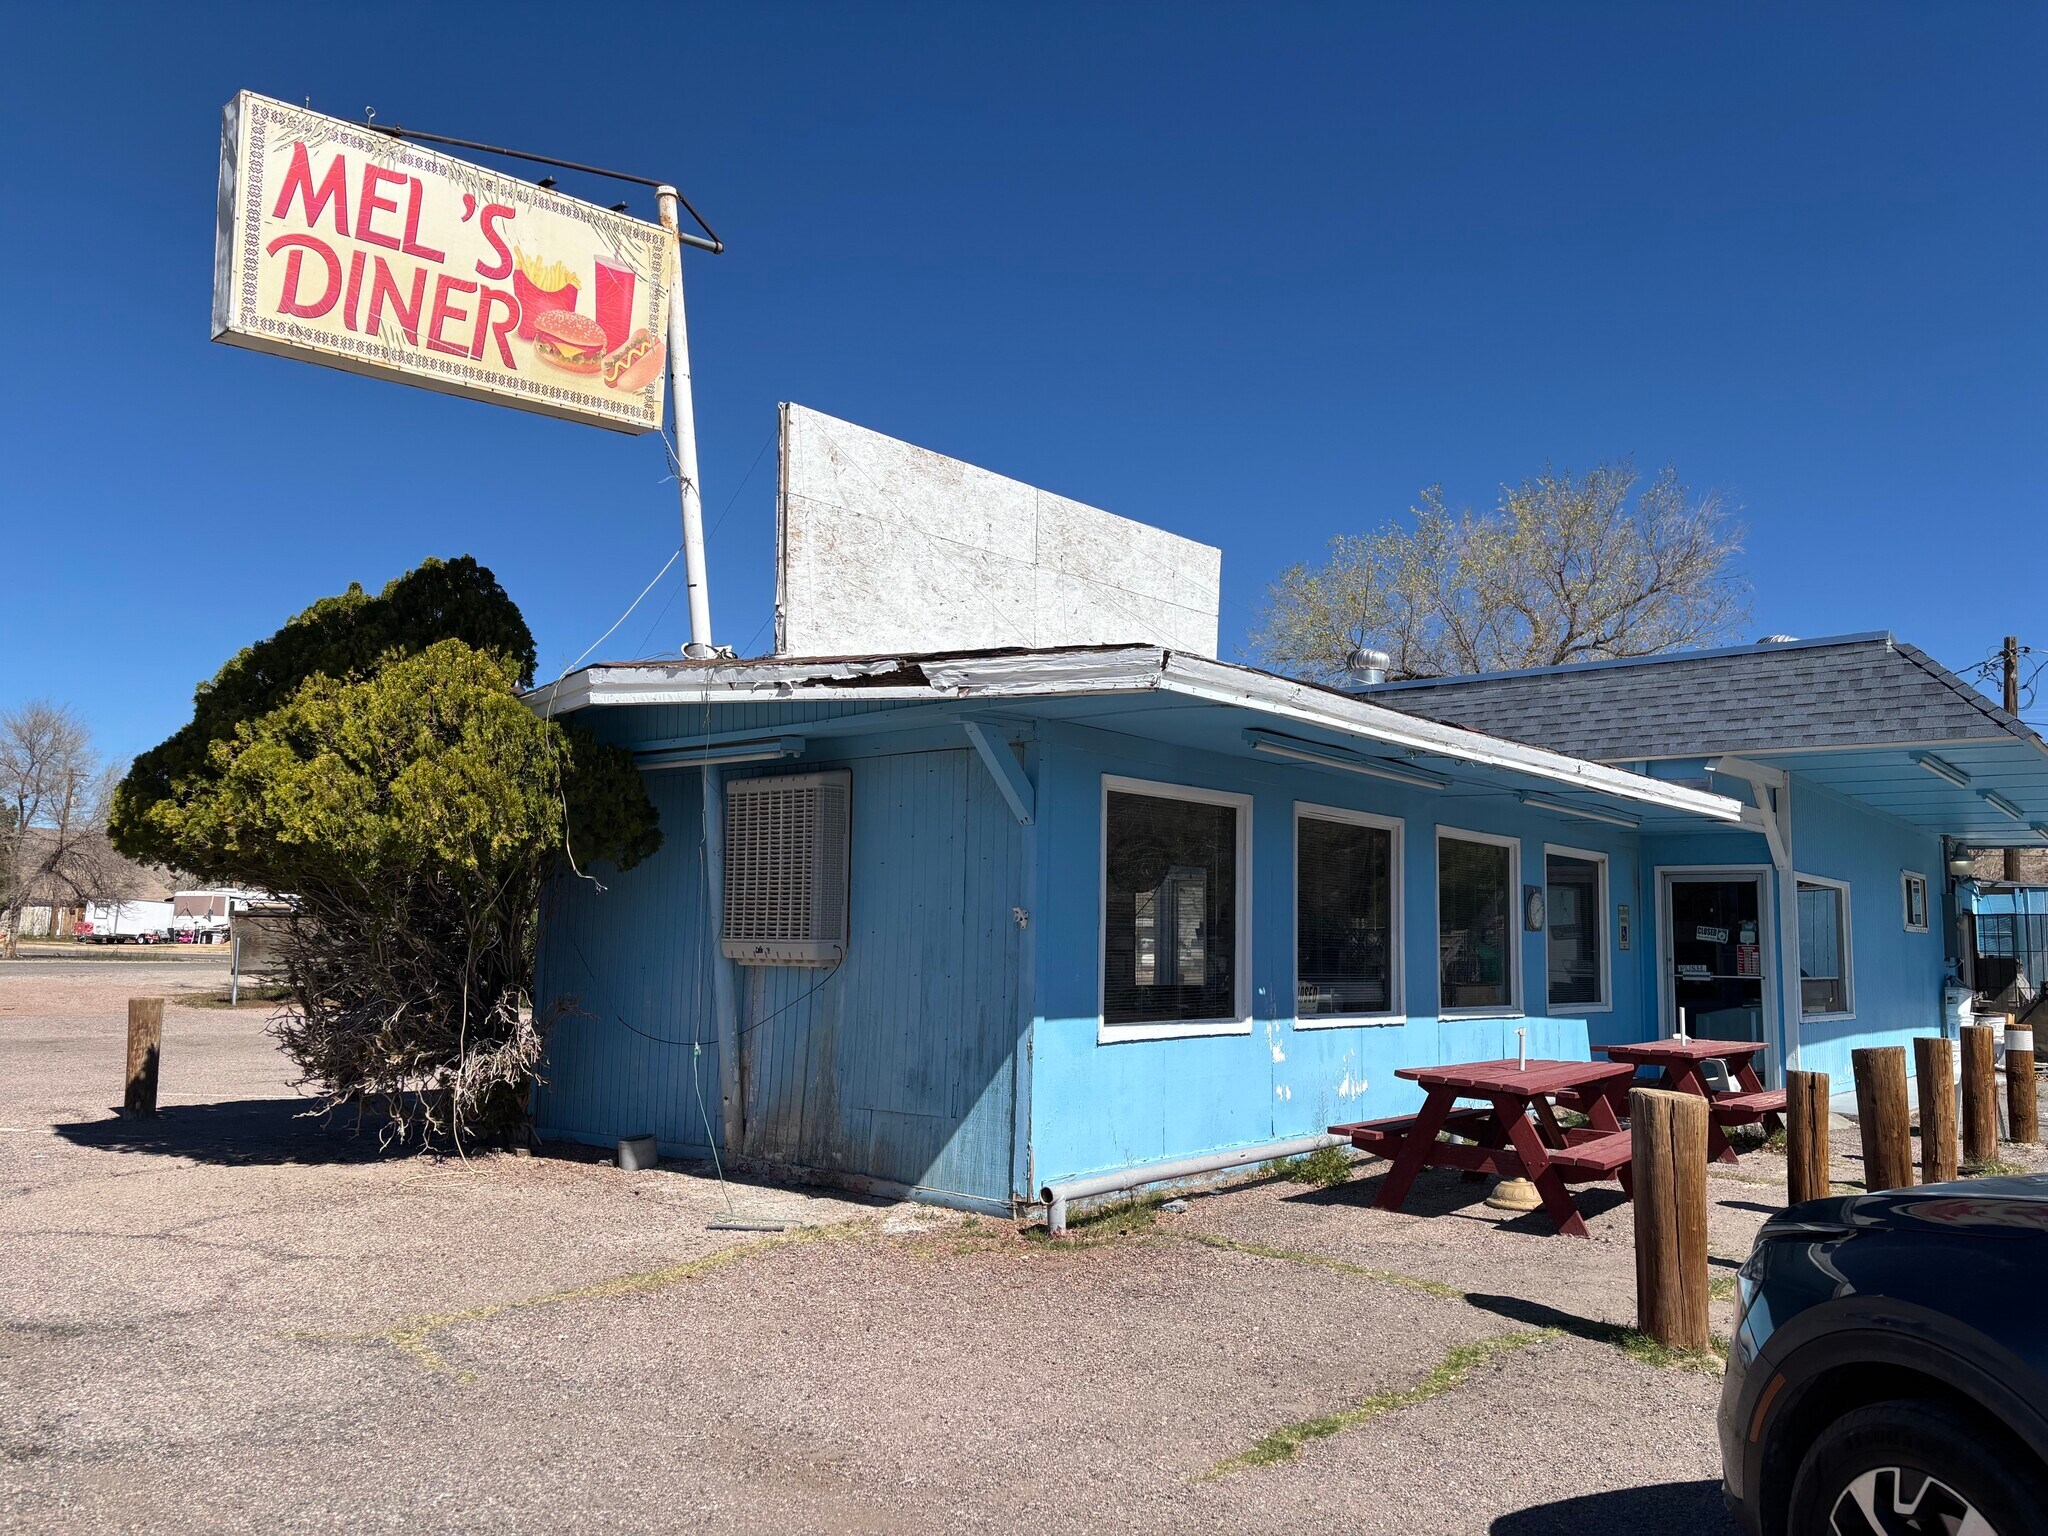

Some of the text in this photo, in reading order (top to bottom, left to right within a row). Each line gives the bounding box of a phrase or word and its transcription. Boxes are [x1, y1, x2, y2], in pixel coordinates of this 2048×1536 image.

[272, 141, 516, 280] MEL'S
[266, 233, 520, 370] DINER
[1697, 926, 1717, 936] CLOSED
